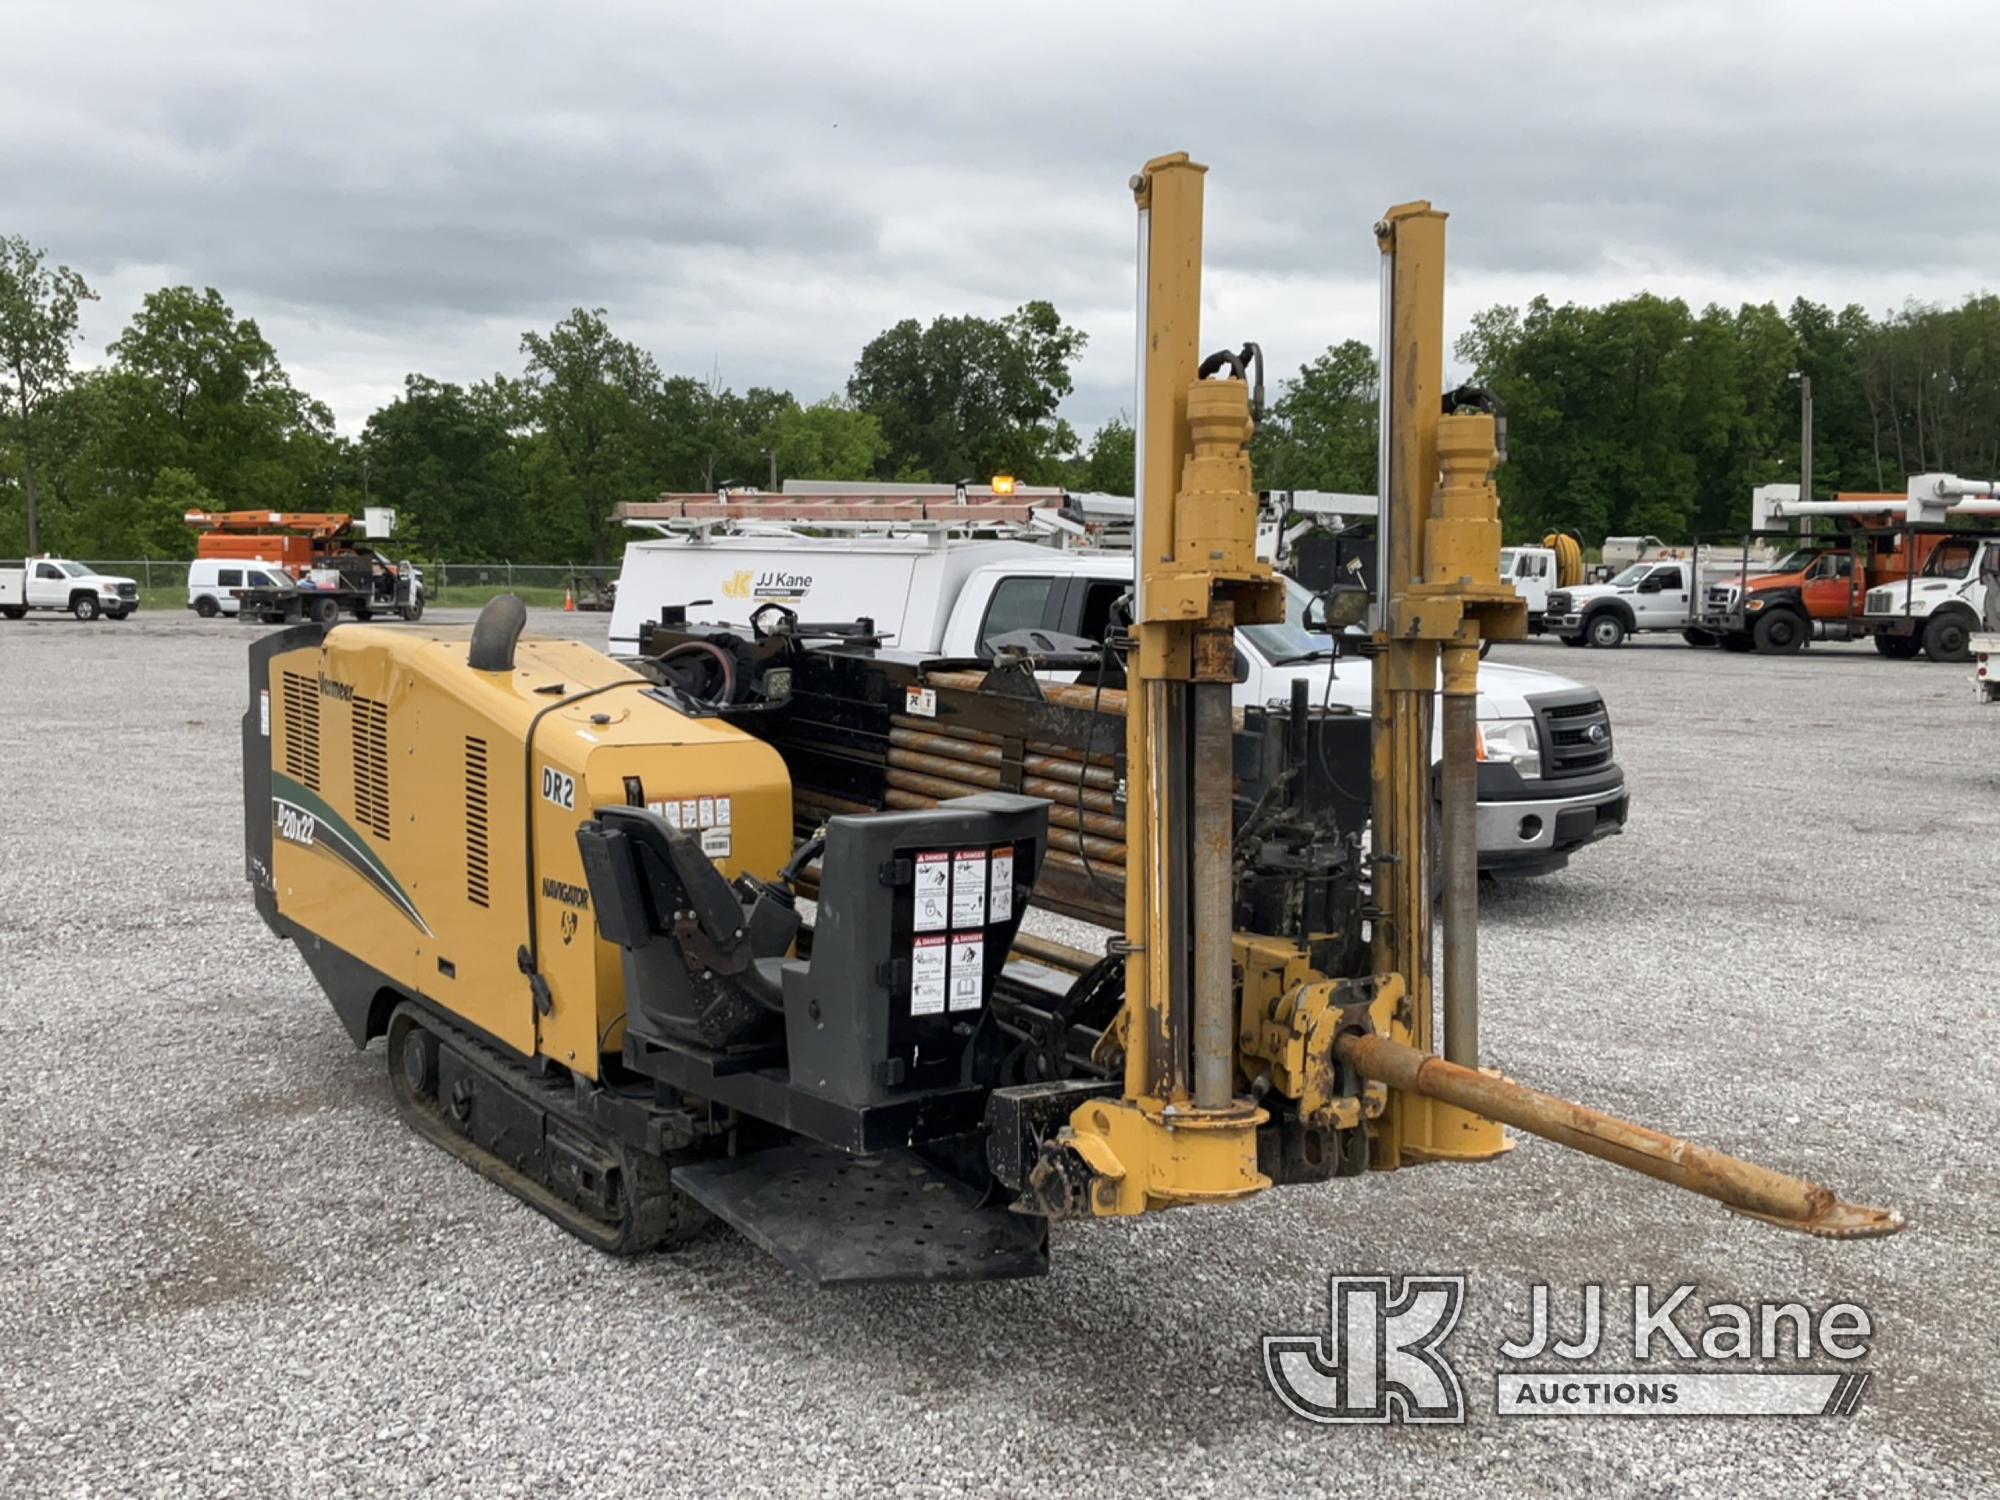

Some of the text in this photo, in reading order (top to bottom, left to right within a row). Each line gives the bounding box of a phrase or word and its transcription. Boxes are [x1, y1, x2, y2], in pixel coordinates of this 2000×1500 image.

[756, 572, 813, 587] JJ Kane
[317, 671, 355, 702] Vermeer
[543, 768, 574, 809] DR2
[924, 853, 948, 861] DANGER
[962, 850, 986, 859] DANGER
[542, 877, 590, 912] NAVIGATOR
[922, 936, 946, 945] DANGER
[960, 933, 983, 942] DANGER
